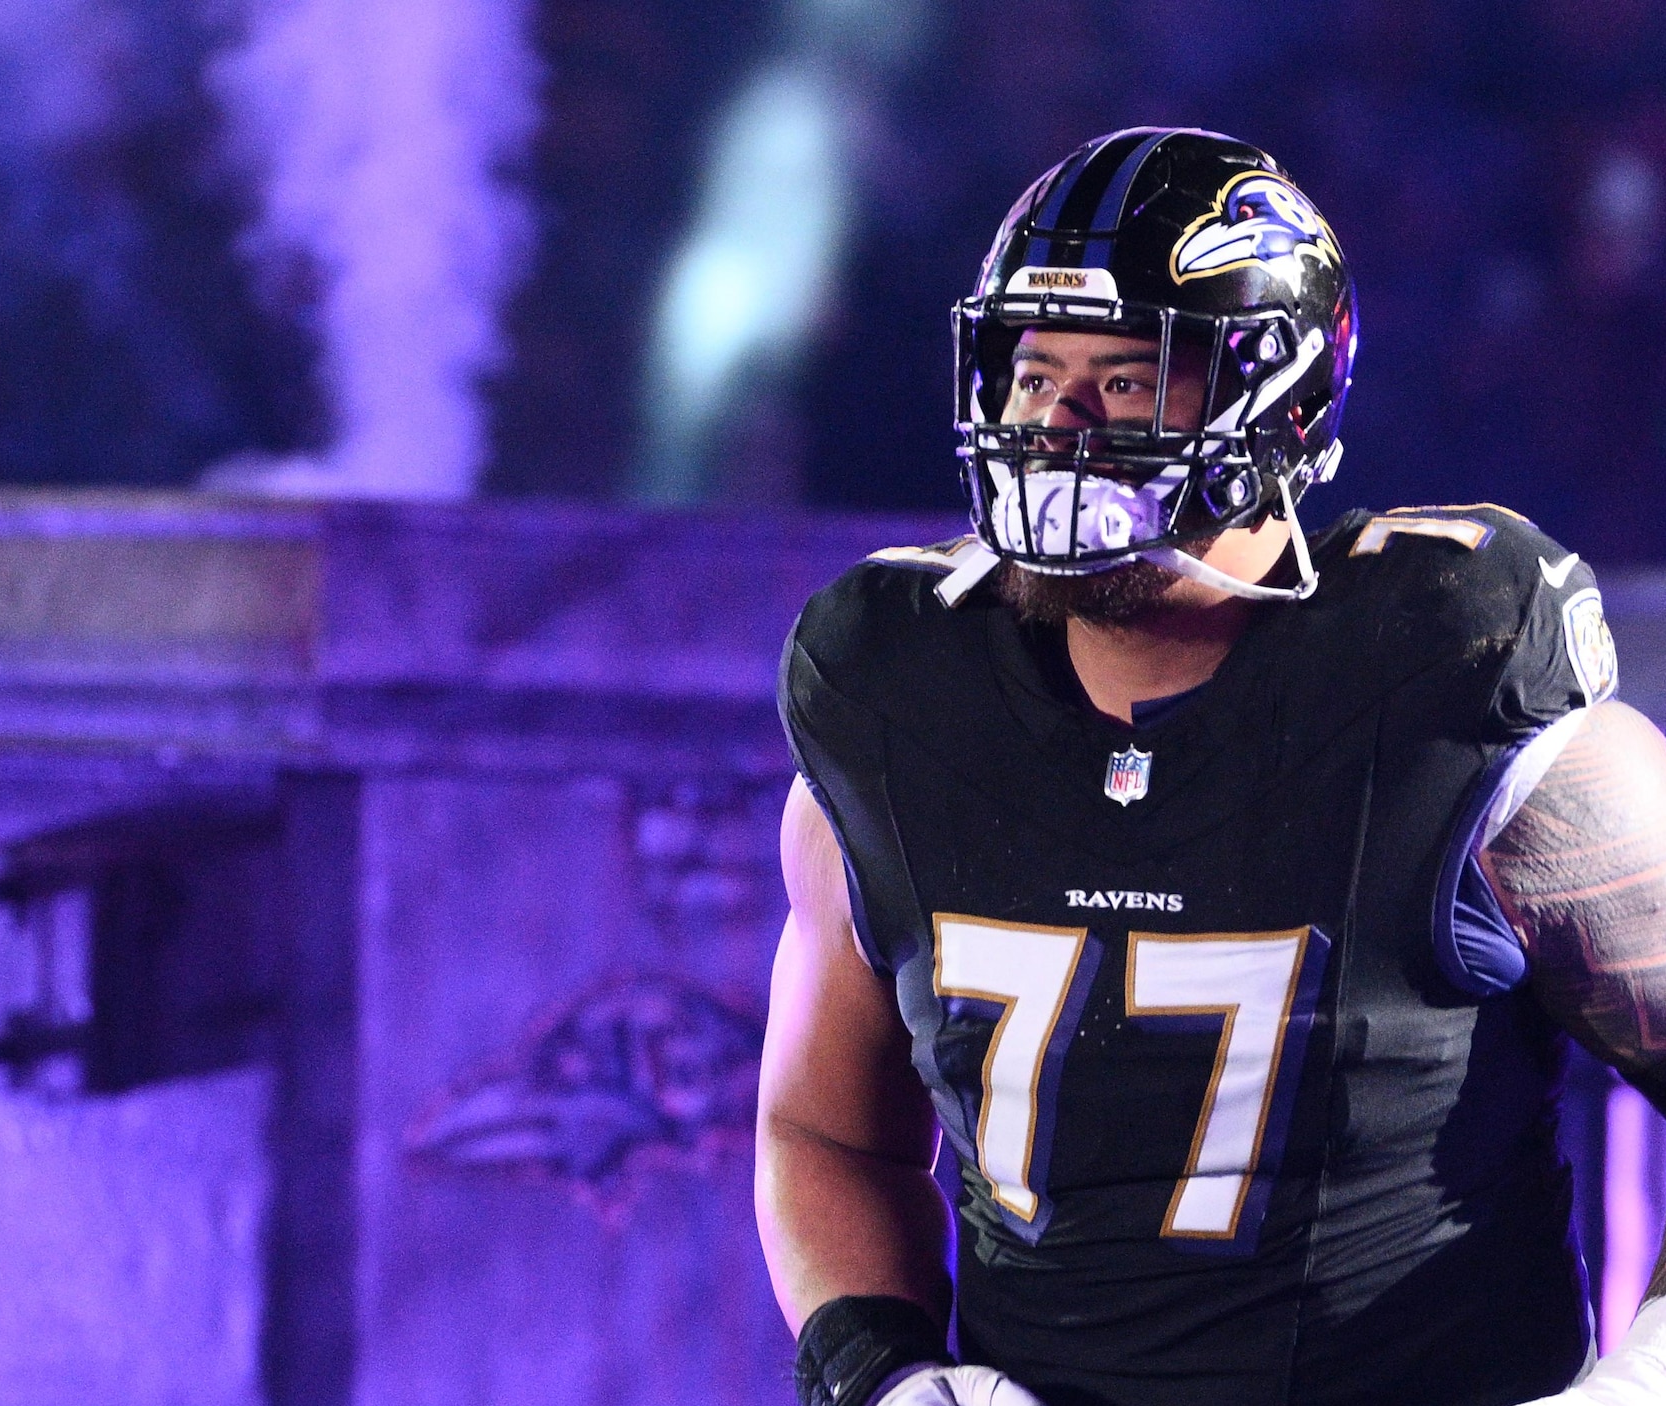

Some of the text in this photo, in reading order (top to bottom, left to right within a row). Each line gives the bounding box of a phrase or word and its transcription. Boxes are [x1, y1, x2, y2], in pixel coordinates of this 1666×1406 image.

[1027, 272, 1087, 289] RAVENS
[1113, 771, 1142, 792] NFL
[1064, 889, 1184, 912] RAVENS
[932, 911, 1325, 1250] 77
